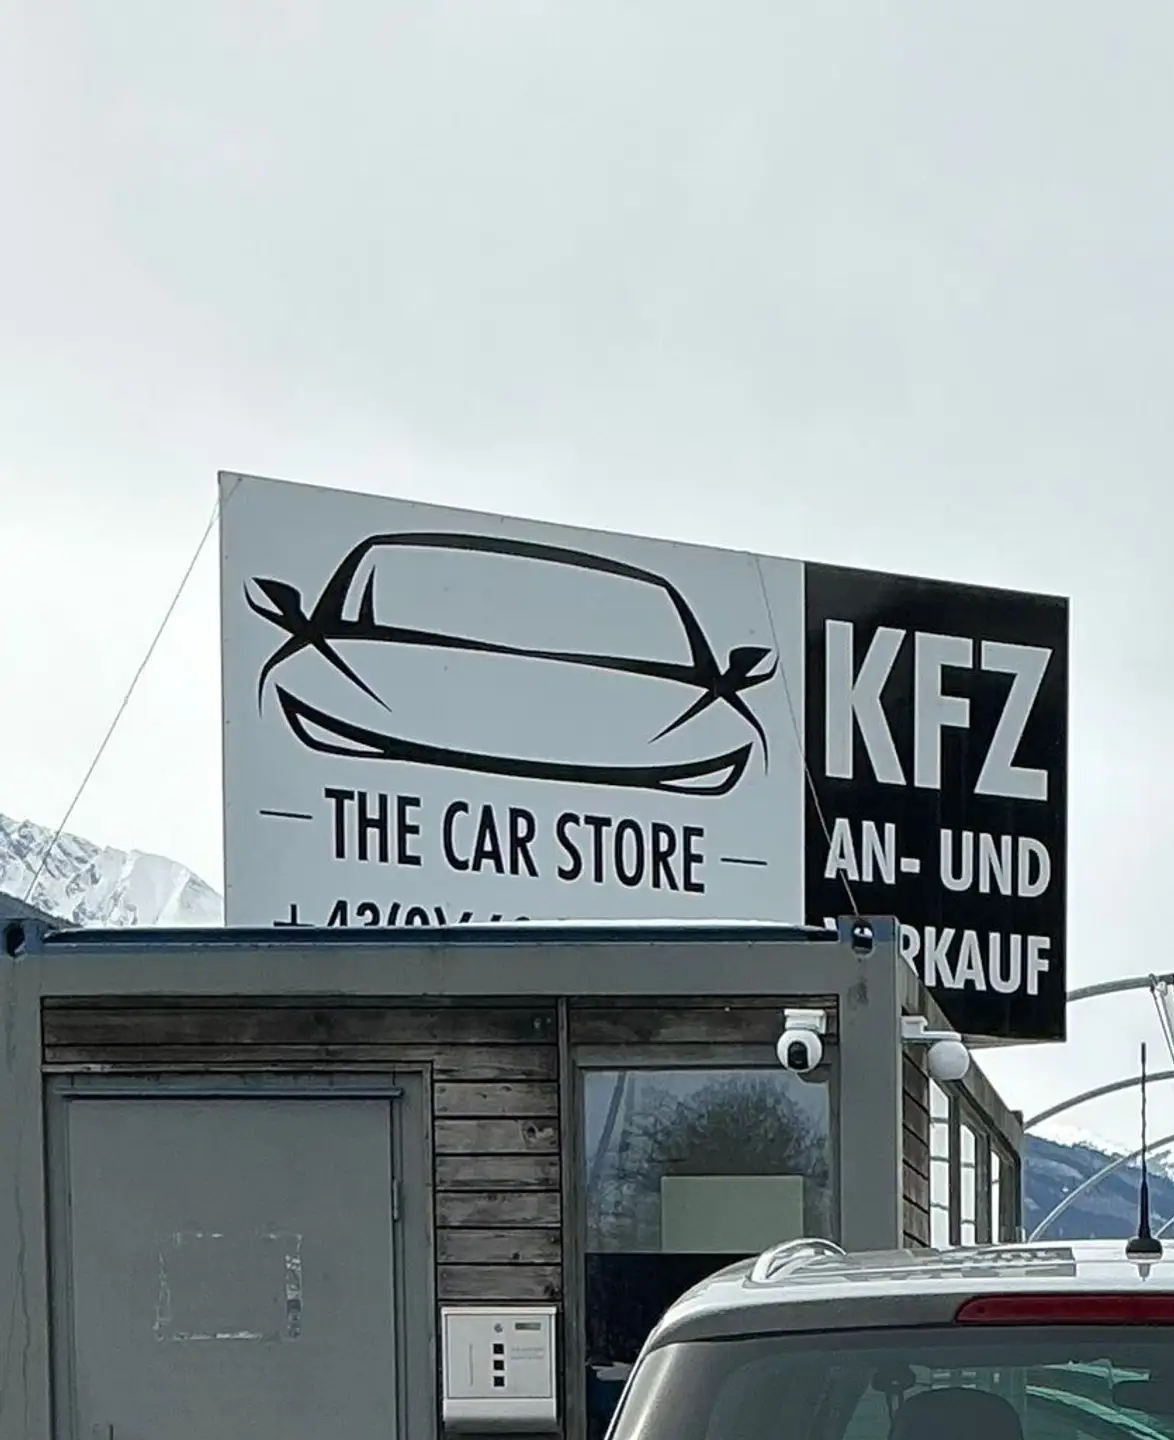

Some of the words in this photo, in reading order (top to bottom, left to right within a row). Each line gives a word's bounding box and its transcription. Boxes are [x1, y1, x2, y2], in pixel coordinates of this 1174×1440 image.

[825, 619, 1053, 801] KFZ
[324, 787, 422, 867] THE
[442, 801, 539, 877] CAR
[555, 812, 706, 893] STORE
[824, 817, 921, 885] AN-
[940, 828, 1051, 898] UND
[823, 917, 1051, 996] RKAUF
